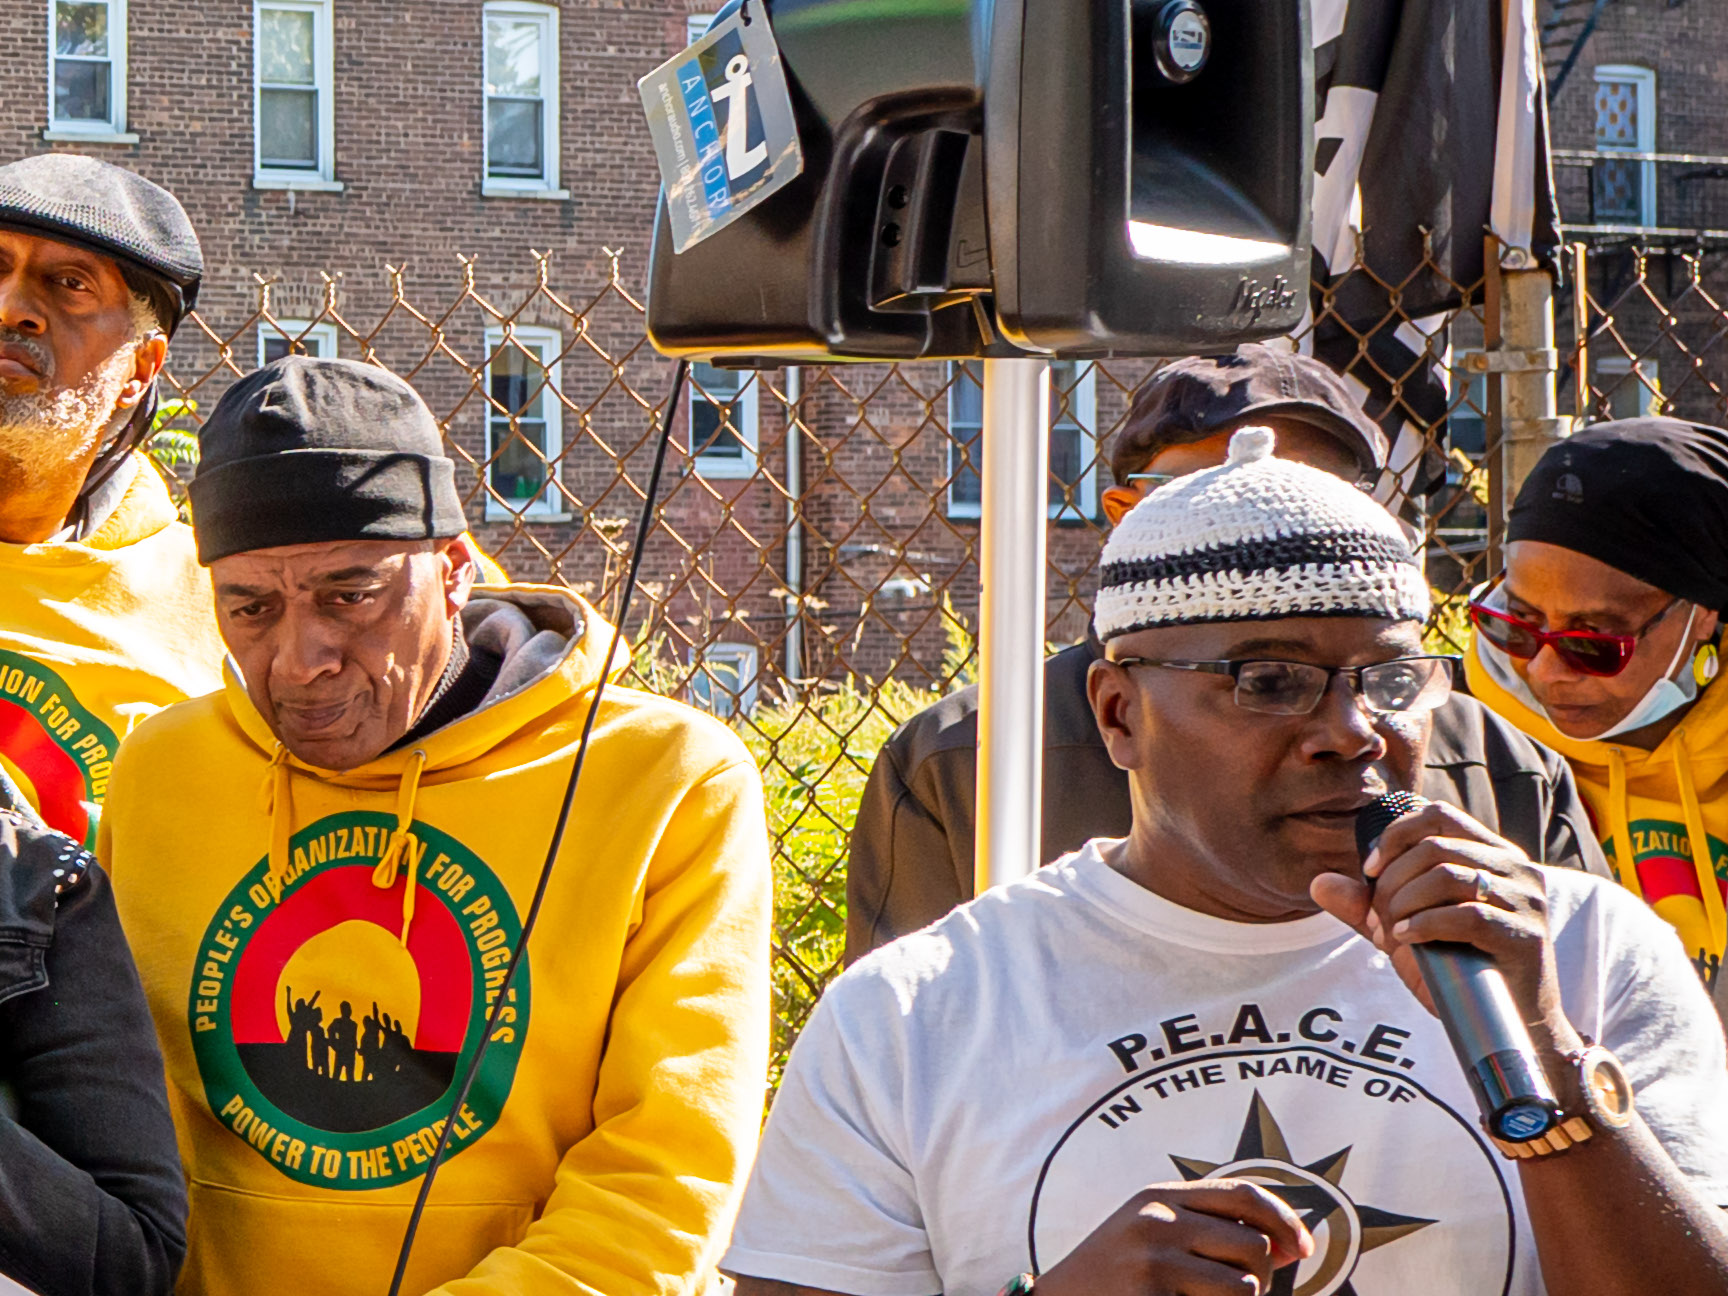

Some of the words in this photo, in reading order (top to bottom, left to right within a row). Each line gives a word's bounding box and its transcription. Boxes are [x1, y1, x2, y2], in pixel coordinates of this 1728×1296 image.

[681, 75, 731, 210] ANCHOR
[39, 693, 81, 741] FOR
[72, 733, 113, 804] PROG
[195, 904, 253, 1032] PEOPLE'S
[248, 826, 428, 910] ORANIZATIN
[425, 853, 476, 901] FOR
[1107, 1004, 1416, 1074] P.E.A.C.E.
[221, 1094, 302, 1171] POWER
[311, 1145, 342, 1179] TO
[346, 1148, 393, 1180] THE
[1098, 1097, 1142, 1131] IN
[1144, 1064, 1226, 1100] THE
[1239, 1056, 1351, 1088] NAME
[1364, 1078, 1417, 1107] OF
